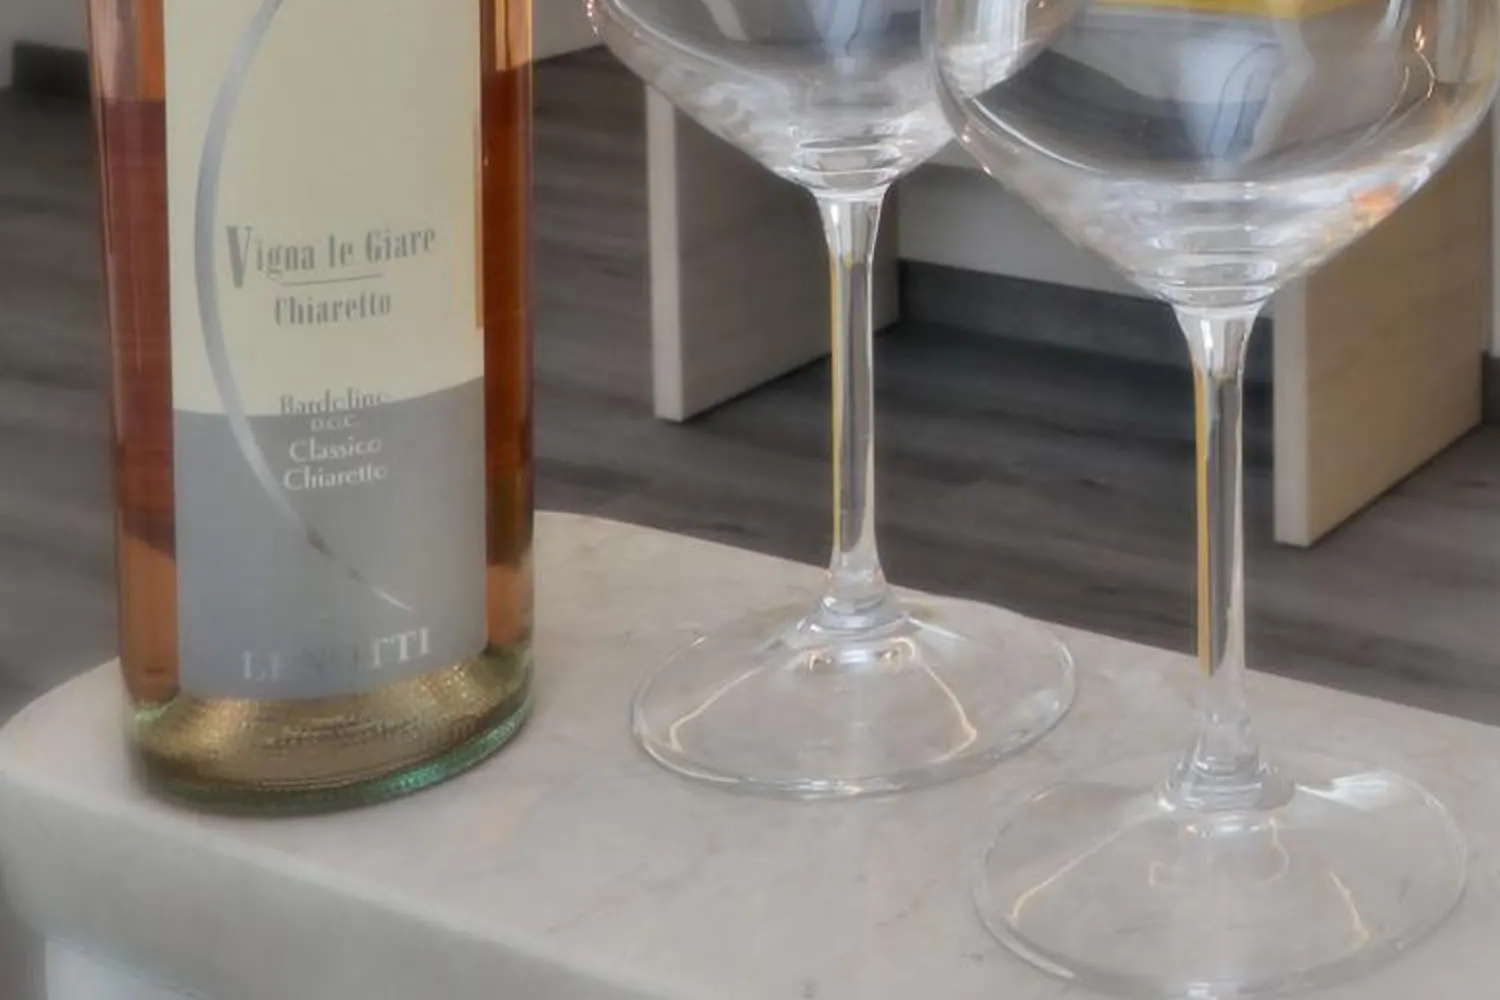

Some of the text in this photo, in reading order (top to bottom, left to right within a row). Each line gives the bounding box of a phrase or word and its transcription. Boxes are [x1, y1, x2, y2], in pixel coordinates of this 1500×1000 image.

[225, 225, 436, 289] Vigna le Giare
[274, 293, 391, 326] Chiaretto
[288, 436, 384, 462] Classico
[283, 464, 389, 491] Chiaretto
[243, 627, 430, 682] LENTTI
